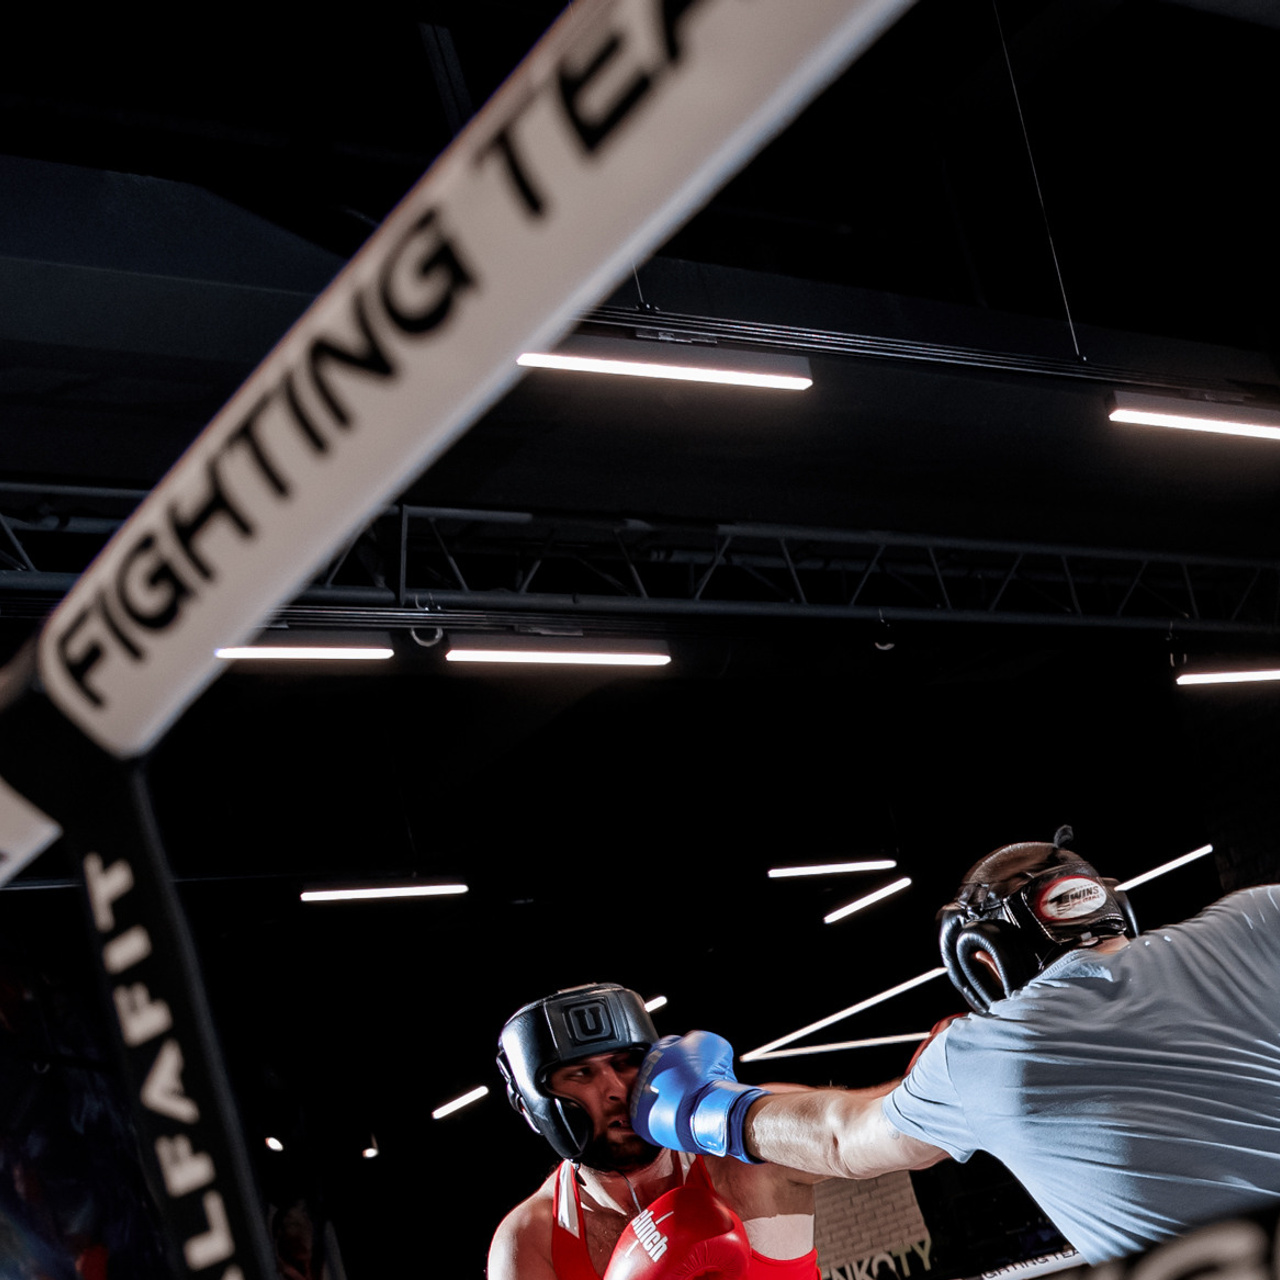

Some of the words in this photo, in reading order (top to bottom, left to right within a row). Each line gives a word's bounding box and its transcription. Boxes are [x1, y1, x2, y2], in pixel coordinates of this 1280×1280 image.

[54, 206, 484, 708] FIGHTING
[468, 0, 712, 219] TE
[631, 1208, 668, 1263] clinch
